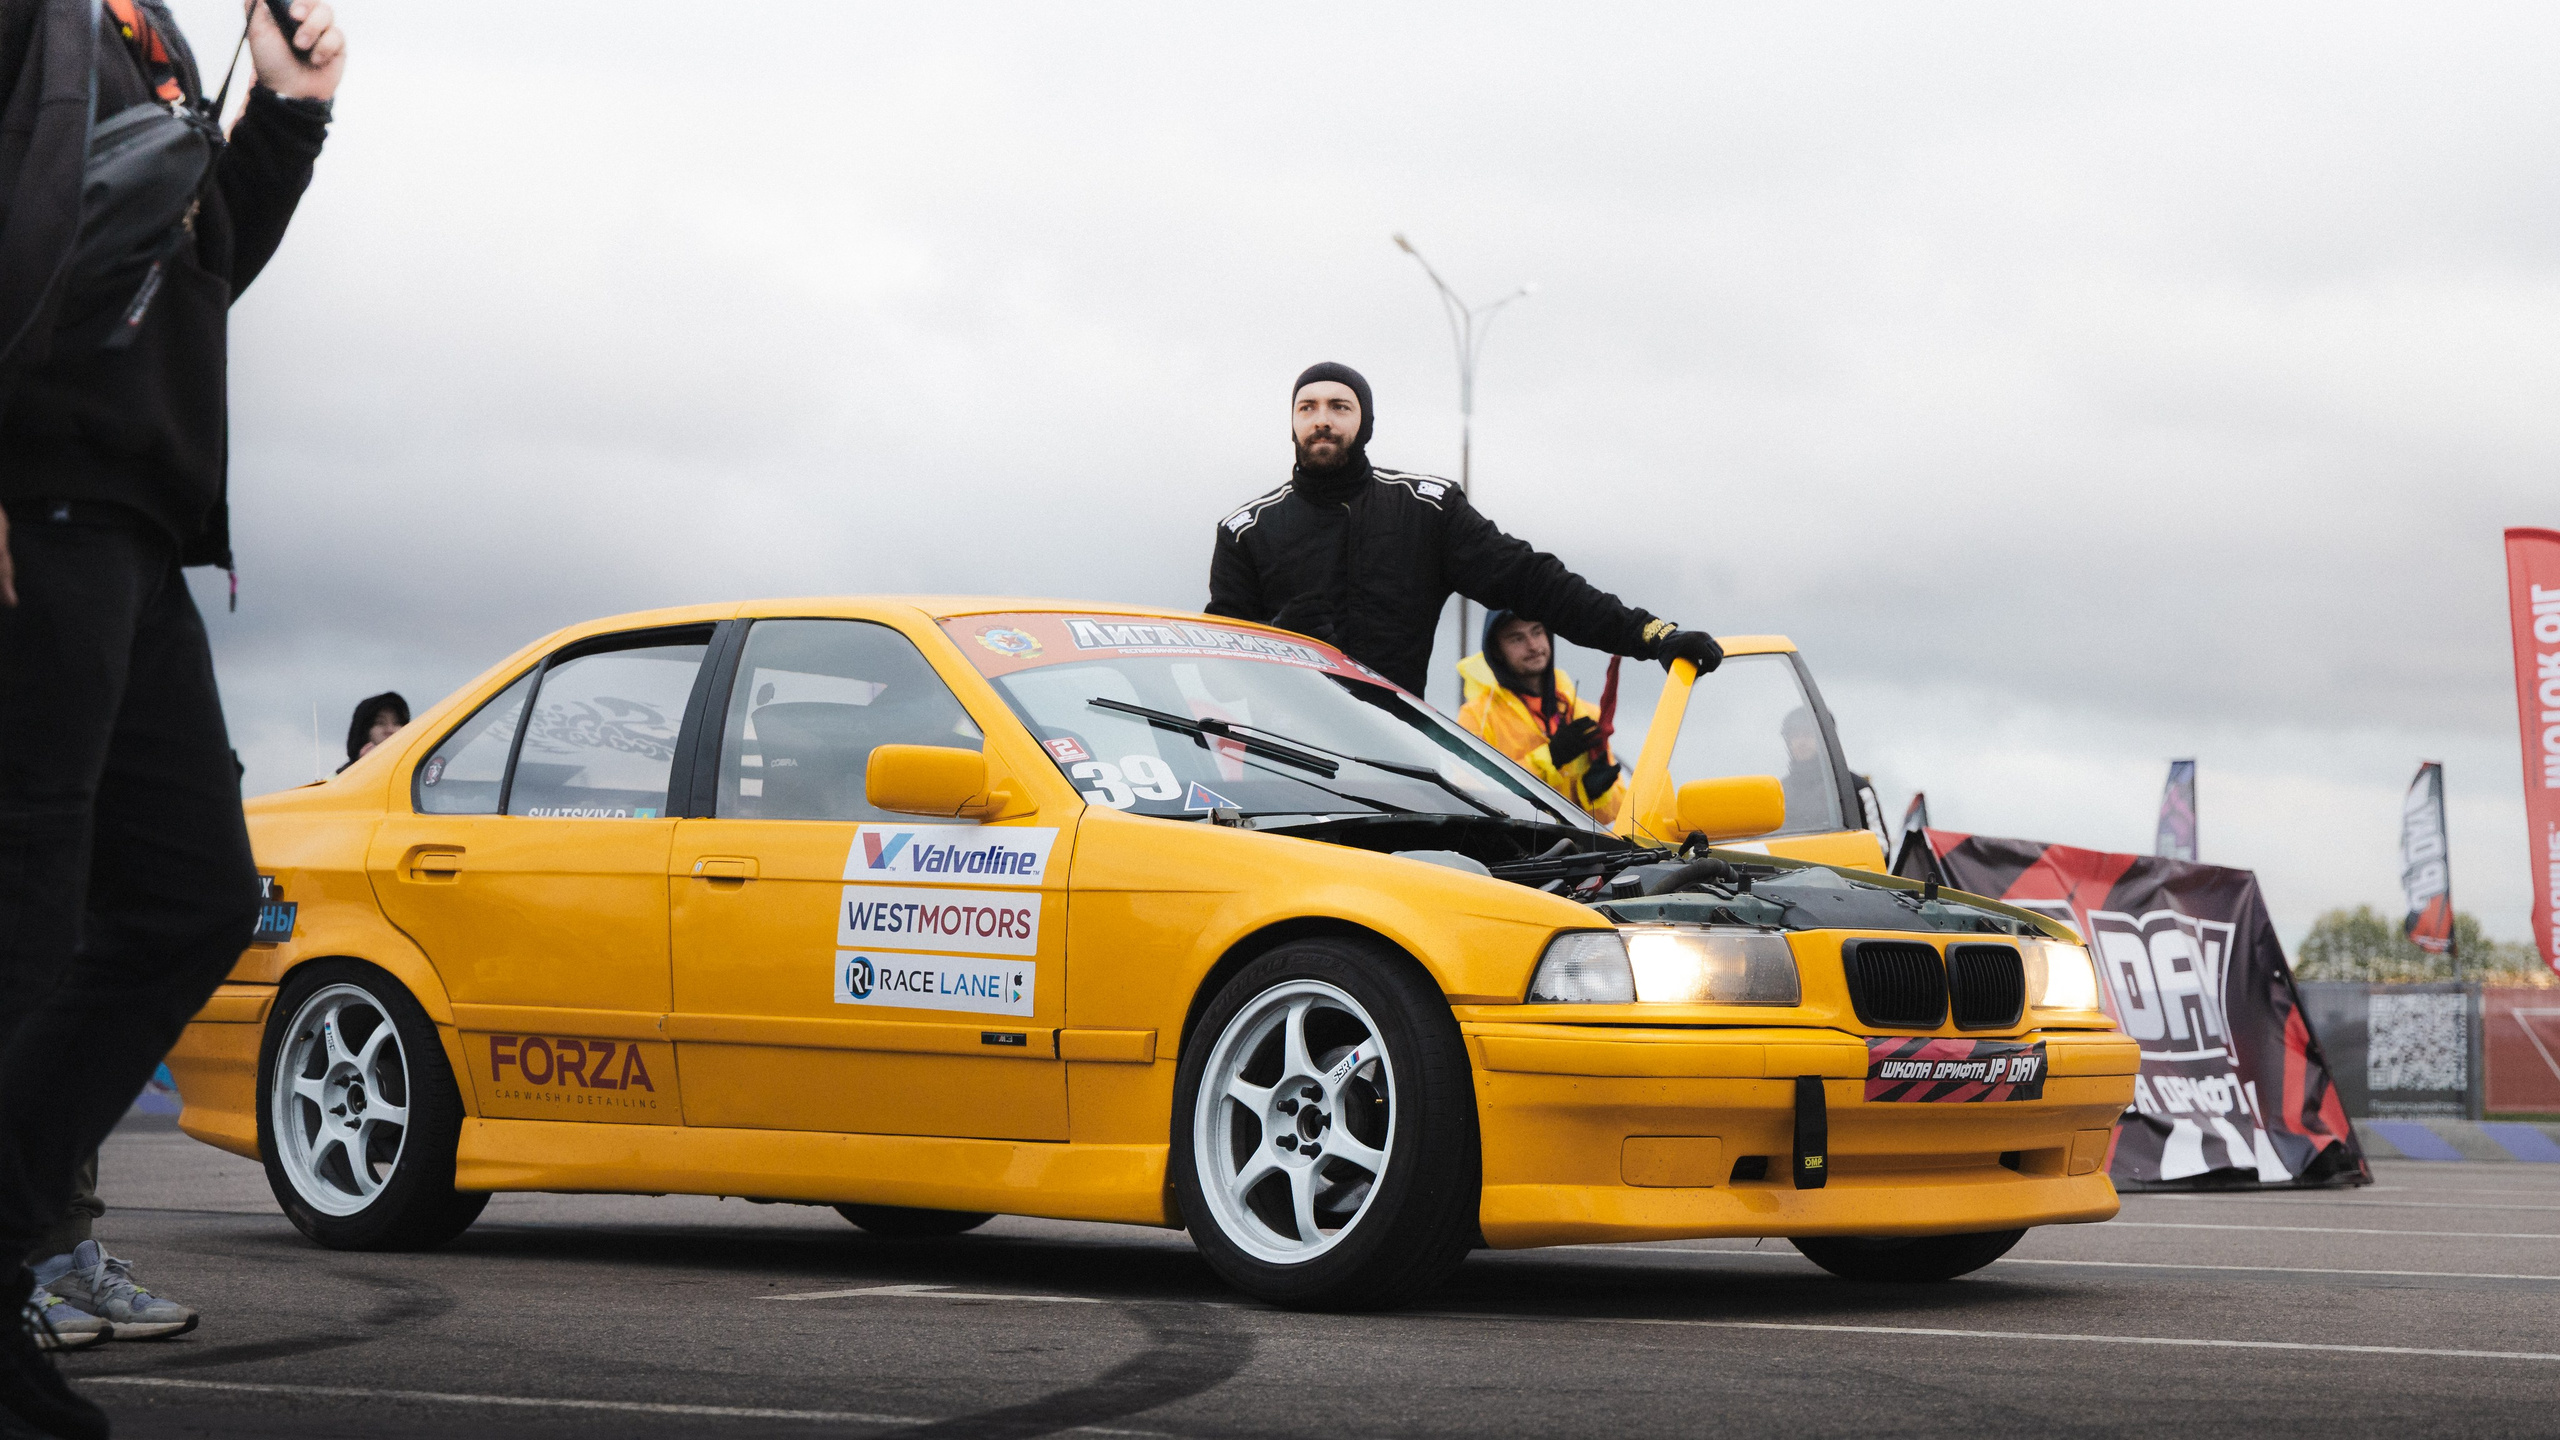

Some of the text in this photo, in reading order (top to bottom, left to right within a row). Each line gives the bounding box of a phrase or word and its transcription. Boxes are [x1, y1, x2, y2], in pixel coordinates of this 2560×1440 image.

[770, 758, 798, 768] COBRA
[1071, 754, 1183, 810] 39
[848, 900, 1032, 940] WESTMOTORS
[880, 968, 935, 993] RACE
[940, 972, 1001, 998] LANE
[489, 1035, 656, 1093] FORZA
[1332, 1060, 1351, 1085] SSR
[1880, 1061, 1987, 1079] ШКОЛА ДРИФТА
[1983, 1057, 2041, 1083] JP DAY
[1804, 1156, 1823, 1168] OMP
